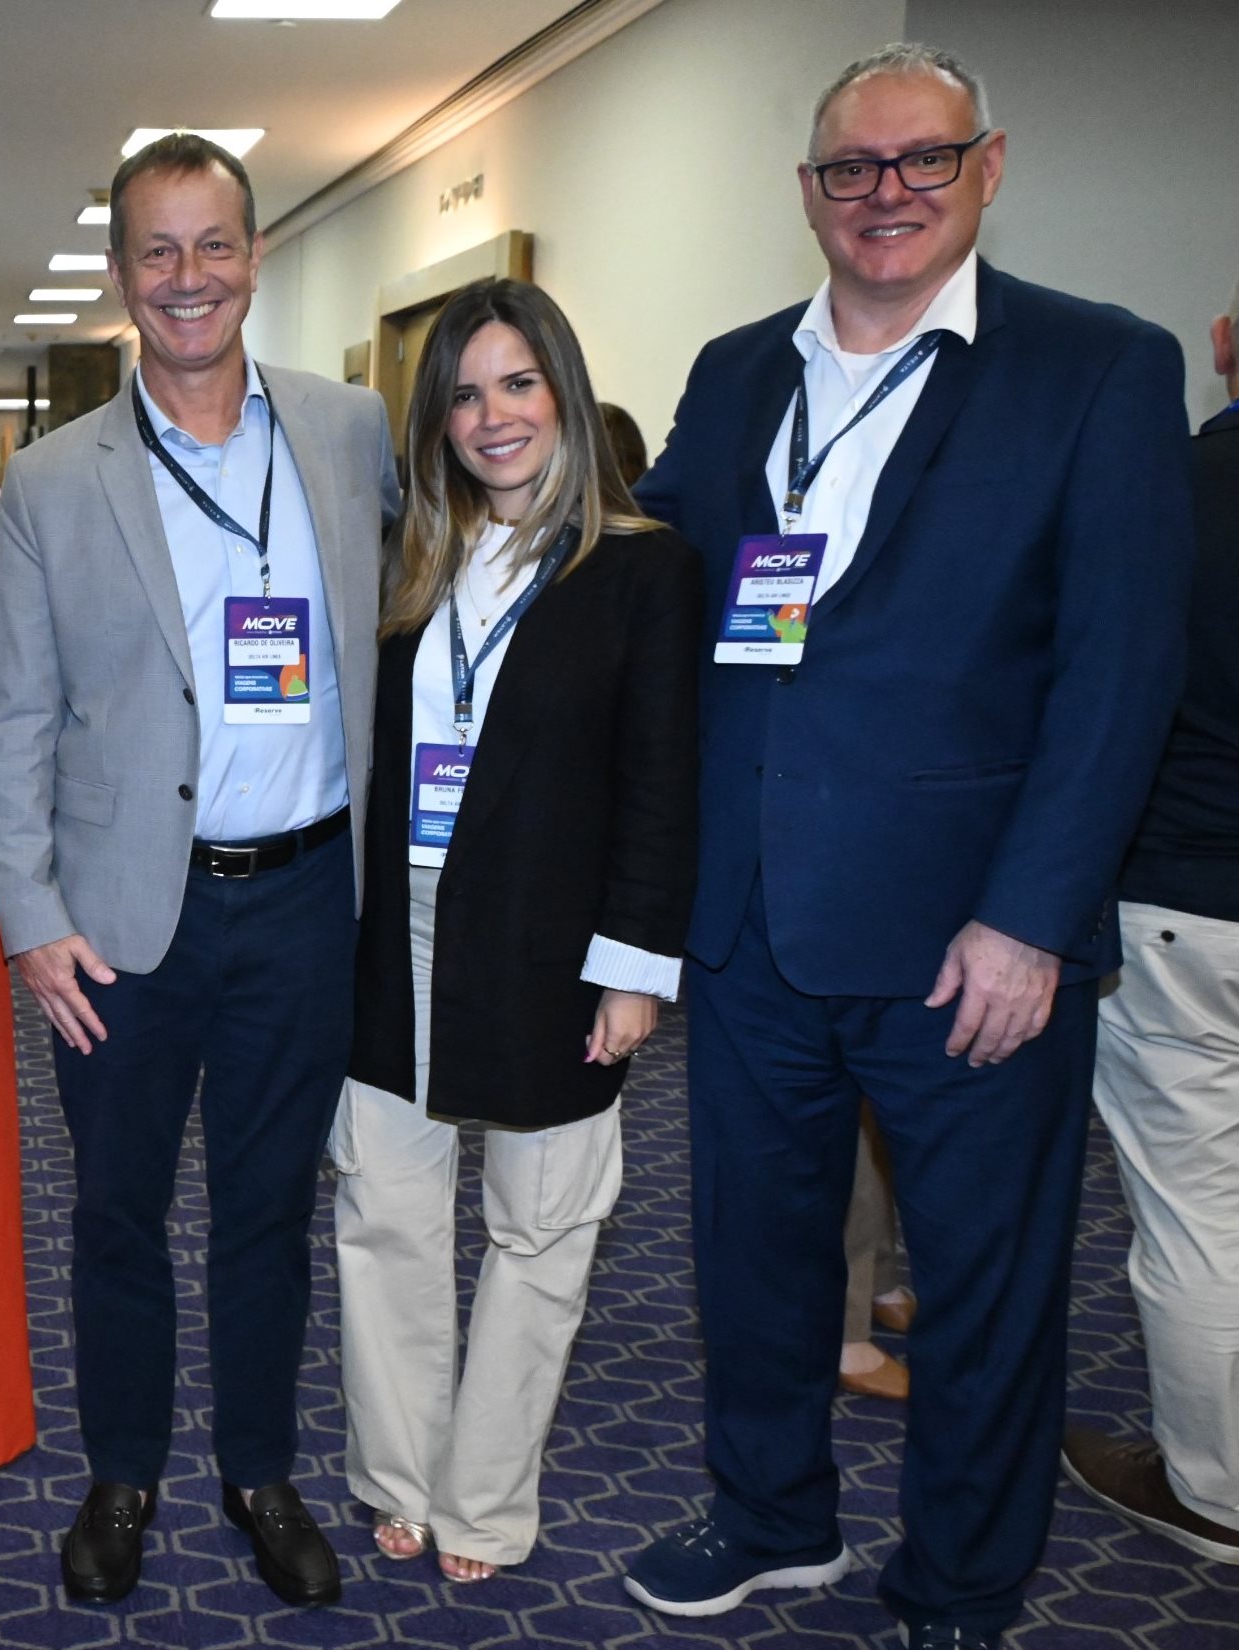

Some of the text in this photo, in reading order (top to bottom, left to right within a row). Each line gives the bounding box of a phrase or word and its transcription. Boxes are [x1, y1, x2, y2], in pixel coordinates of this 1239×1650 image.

[751, 553, 811, 568] MOVE
[242, 617, 298, 631] MOVE
[433, 764, 470, 778] MO
